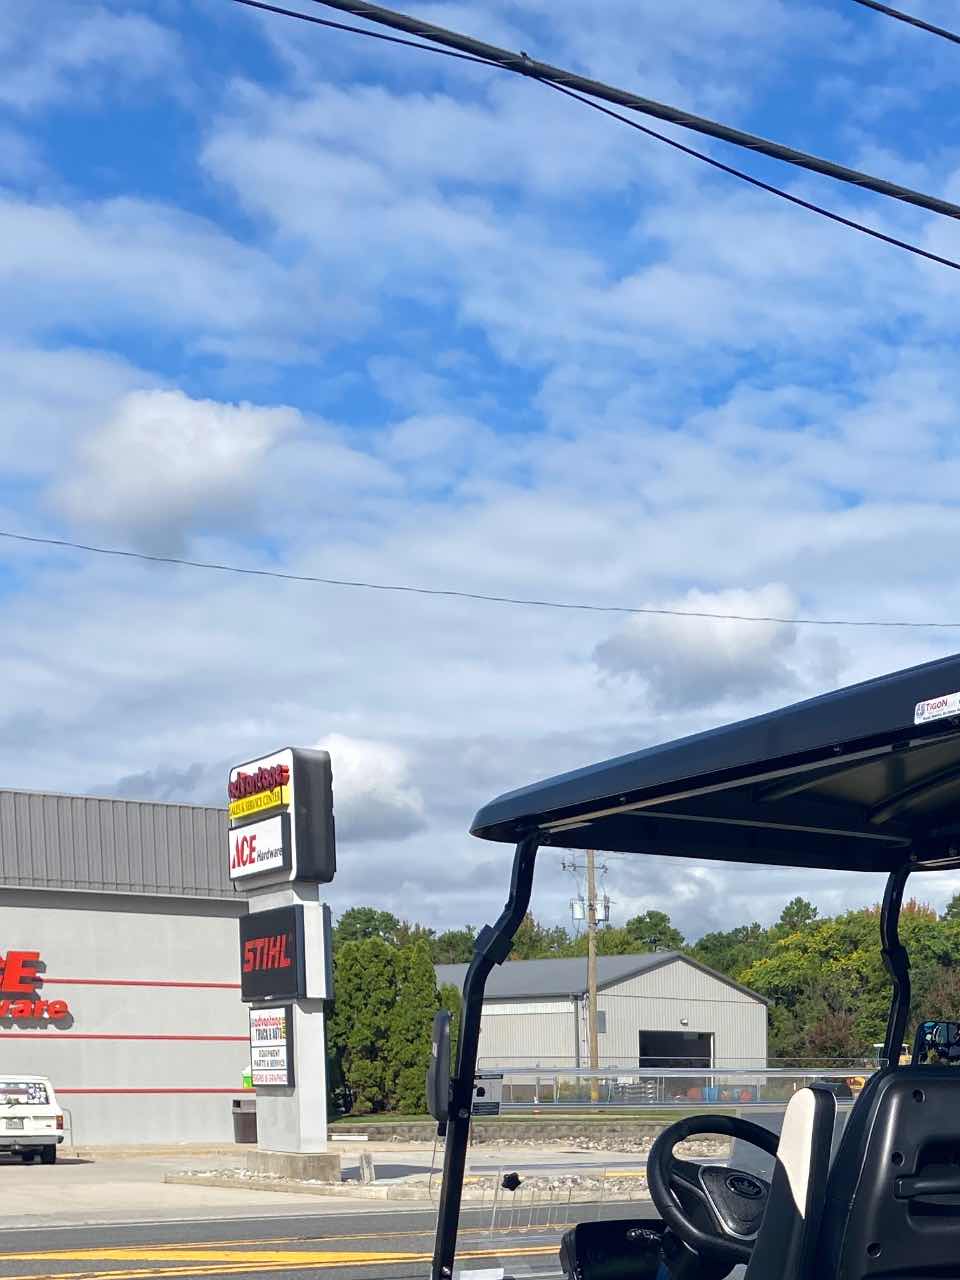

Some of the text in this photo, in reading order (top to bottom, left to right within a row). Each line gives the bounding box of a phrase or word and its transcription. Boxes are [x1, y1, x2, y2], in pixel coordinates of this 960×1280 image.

[926, 699, 948, 712] TIGON
[232, 834, 257, 869] ACE
[257, 847, 283, 862] Hardware
[243, 934, 291, 973] STIHL
[0, 951, 40, 992] E
